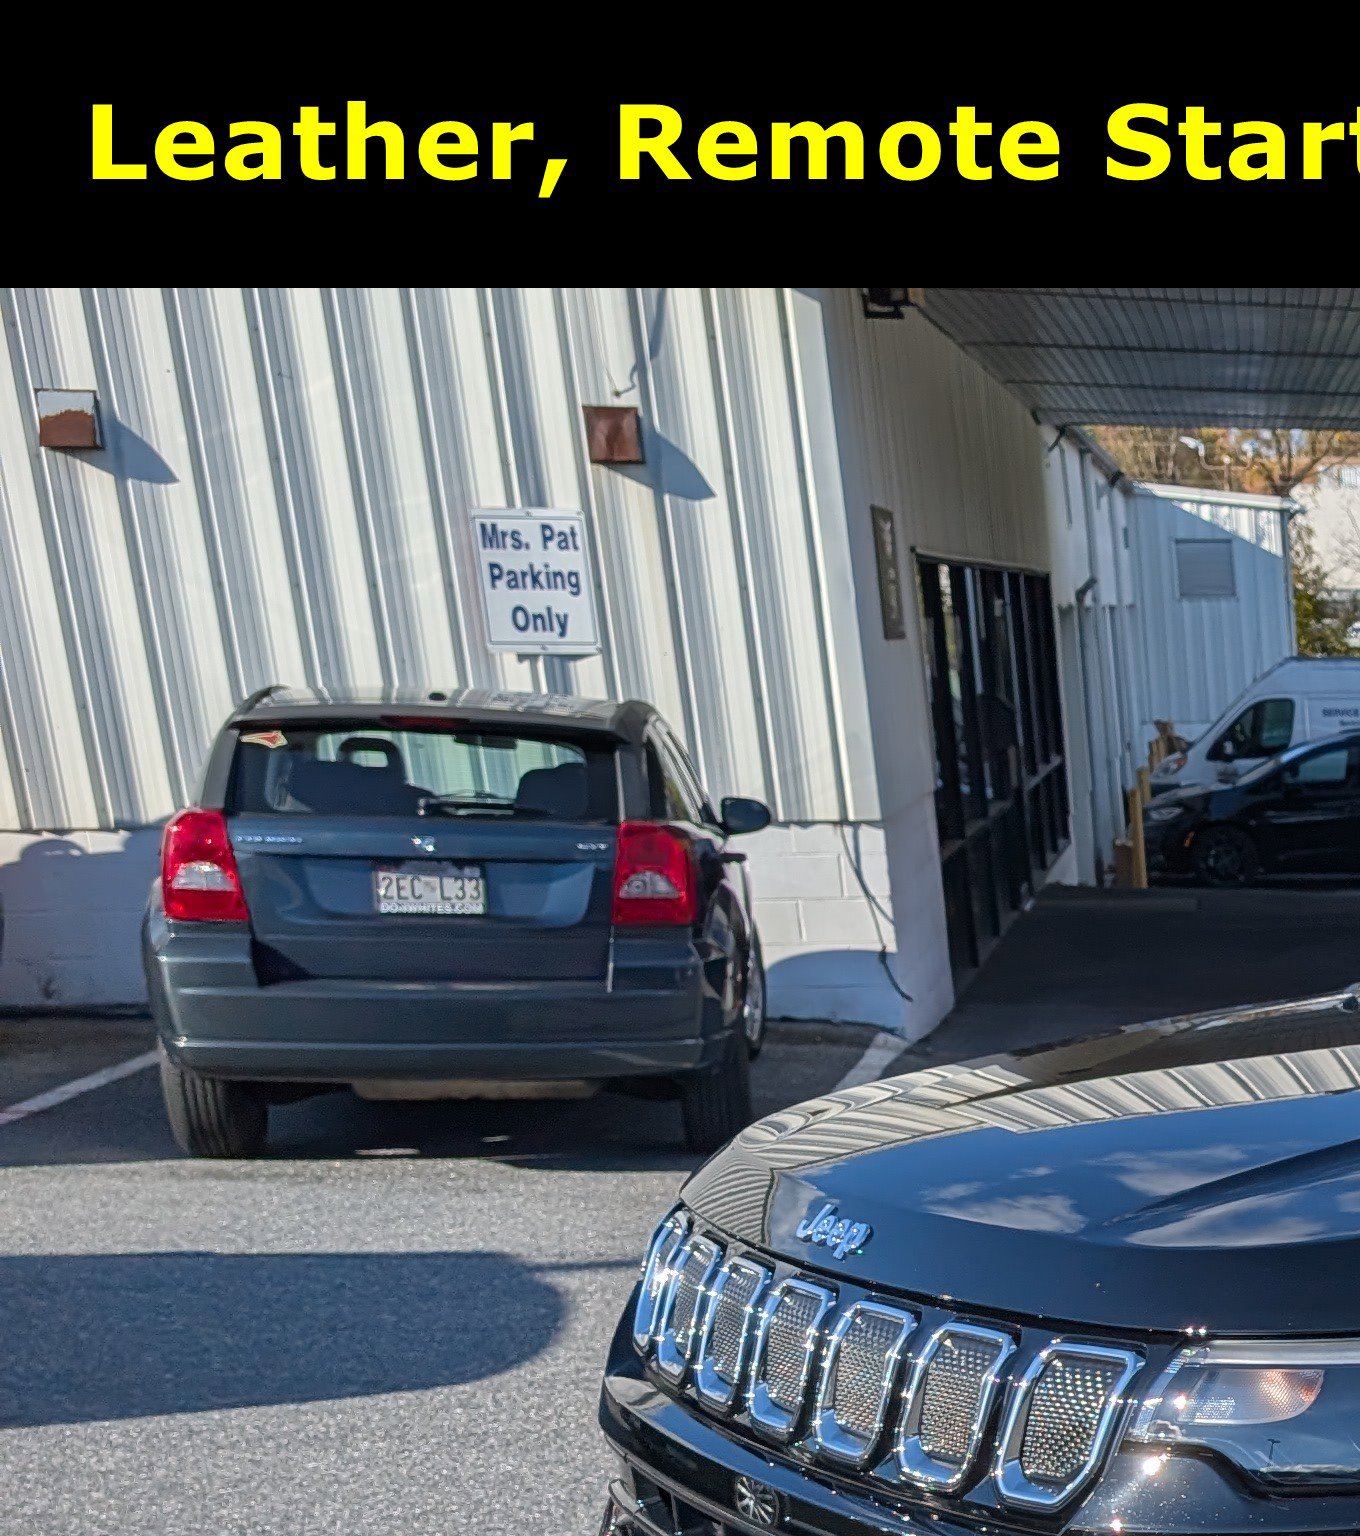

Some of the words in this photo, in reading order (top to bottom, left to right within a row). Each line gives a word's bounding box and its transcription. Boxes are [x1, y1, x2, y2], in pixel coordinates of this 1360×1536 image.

[480, 522, 530, 550] Mrs.
[541, 523, 579, 551] Pat
[488, 562, 581, 597] Parking
[511, 604, 569, 638] Only
[796, 1203, 872, 1260] Jeep
